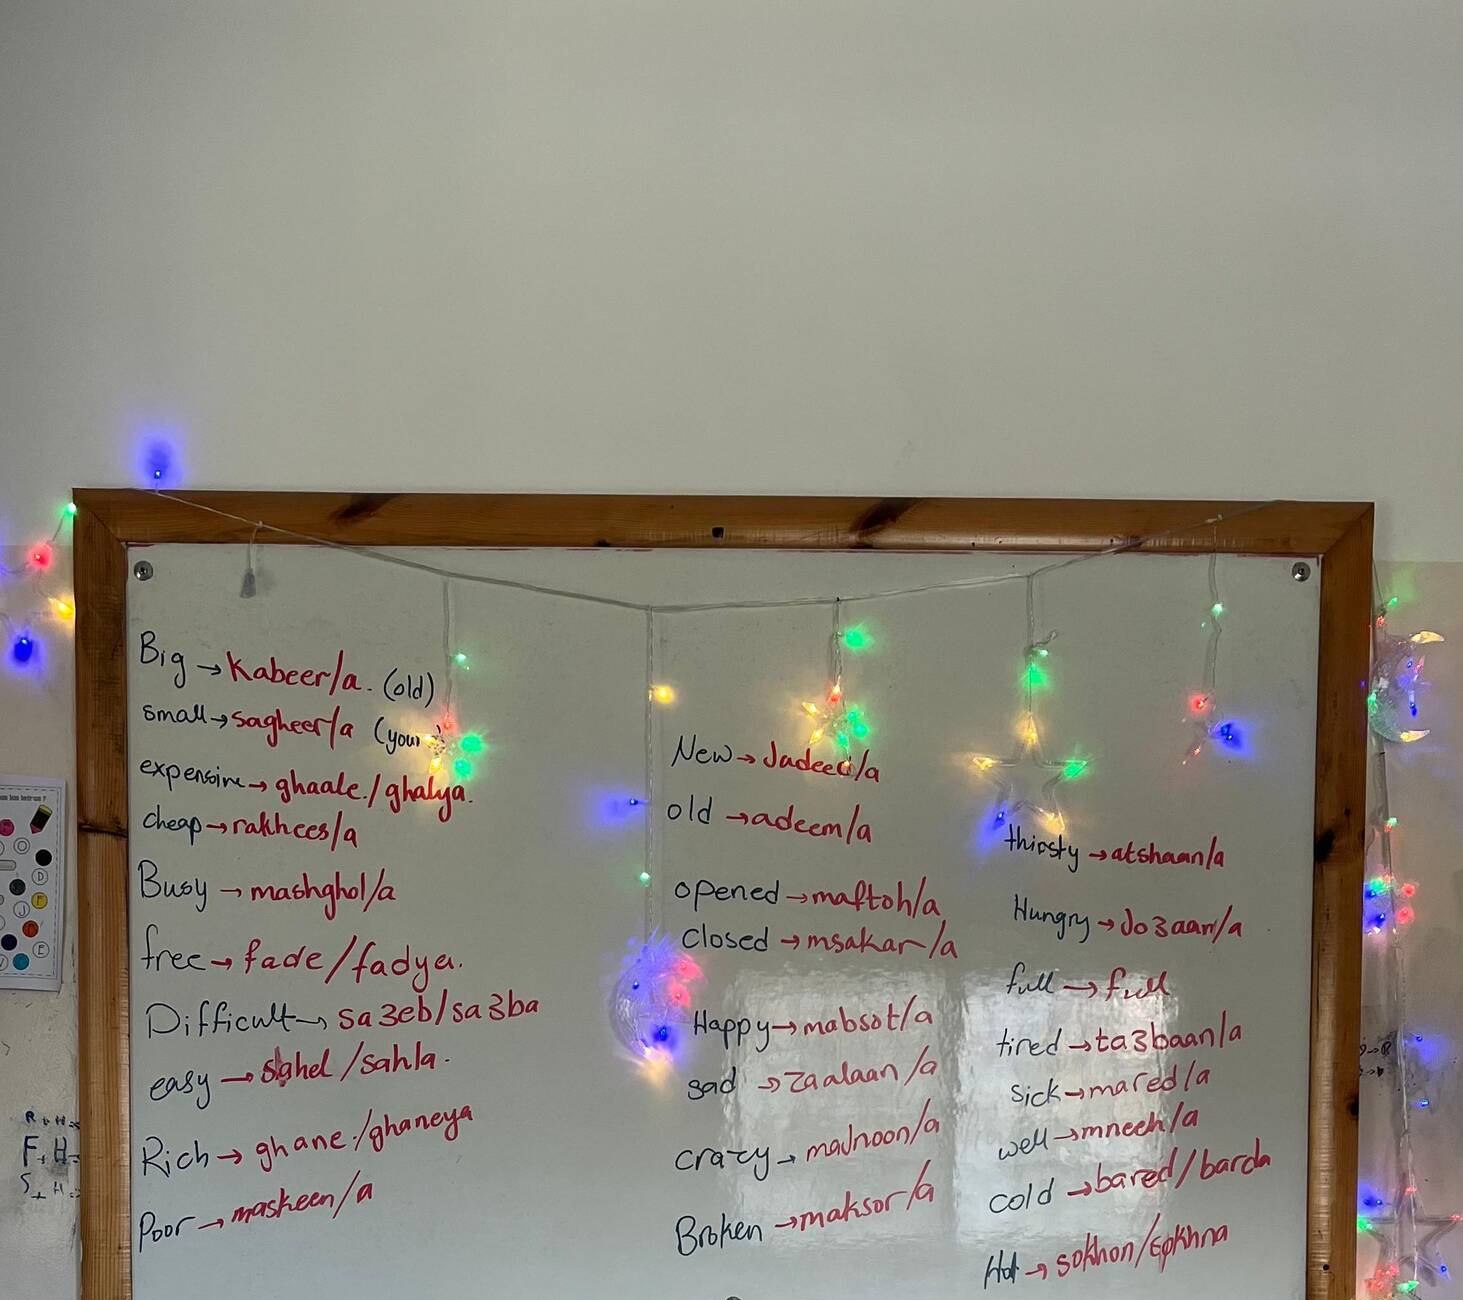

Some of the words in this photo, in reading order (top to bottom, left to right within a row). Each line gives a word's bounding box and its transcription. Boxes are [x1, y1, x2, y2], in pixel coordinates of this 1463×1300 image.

[140, 630, 186, 688] Big
[383, 668, 435, 708] (old)
[671, 734, 733, 767] New
[138, 859, 208, 912] Busy
[1013, 894, 1090, 943] Hungry
[147, 1002, 296, 1039] Difficult
[693, 1010, 770, 1052] Happy
[150, 1073, 211, 1109] easy
[143, 1136, 209, 1178] Rich
[676, 1213, 762, 1256] Broken
